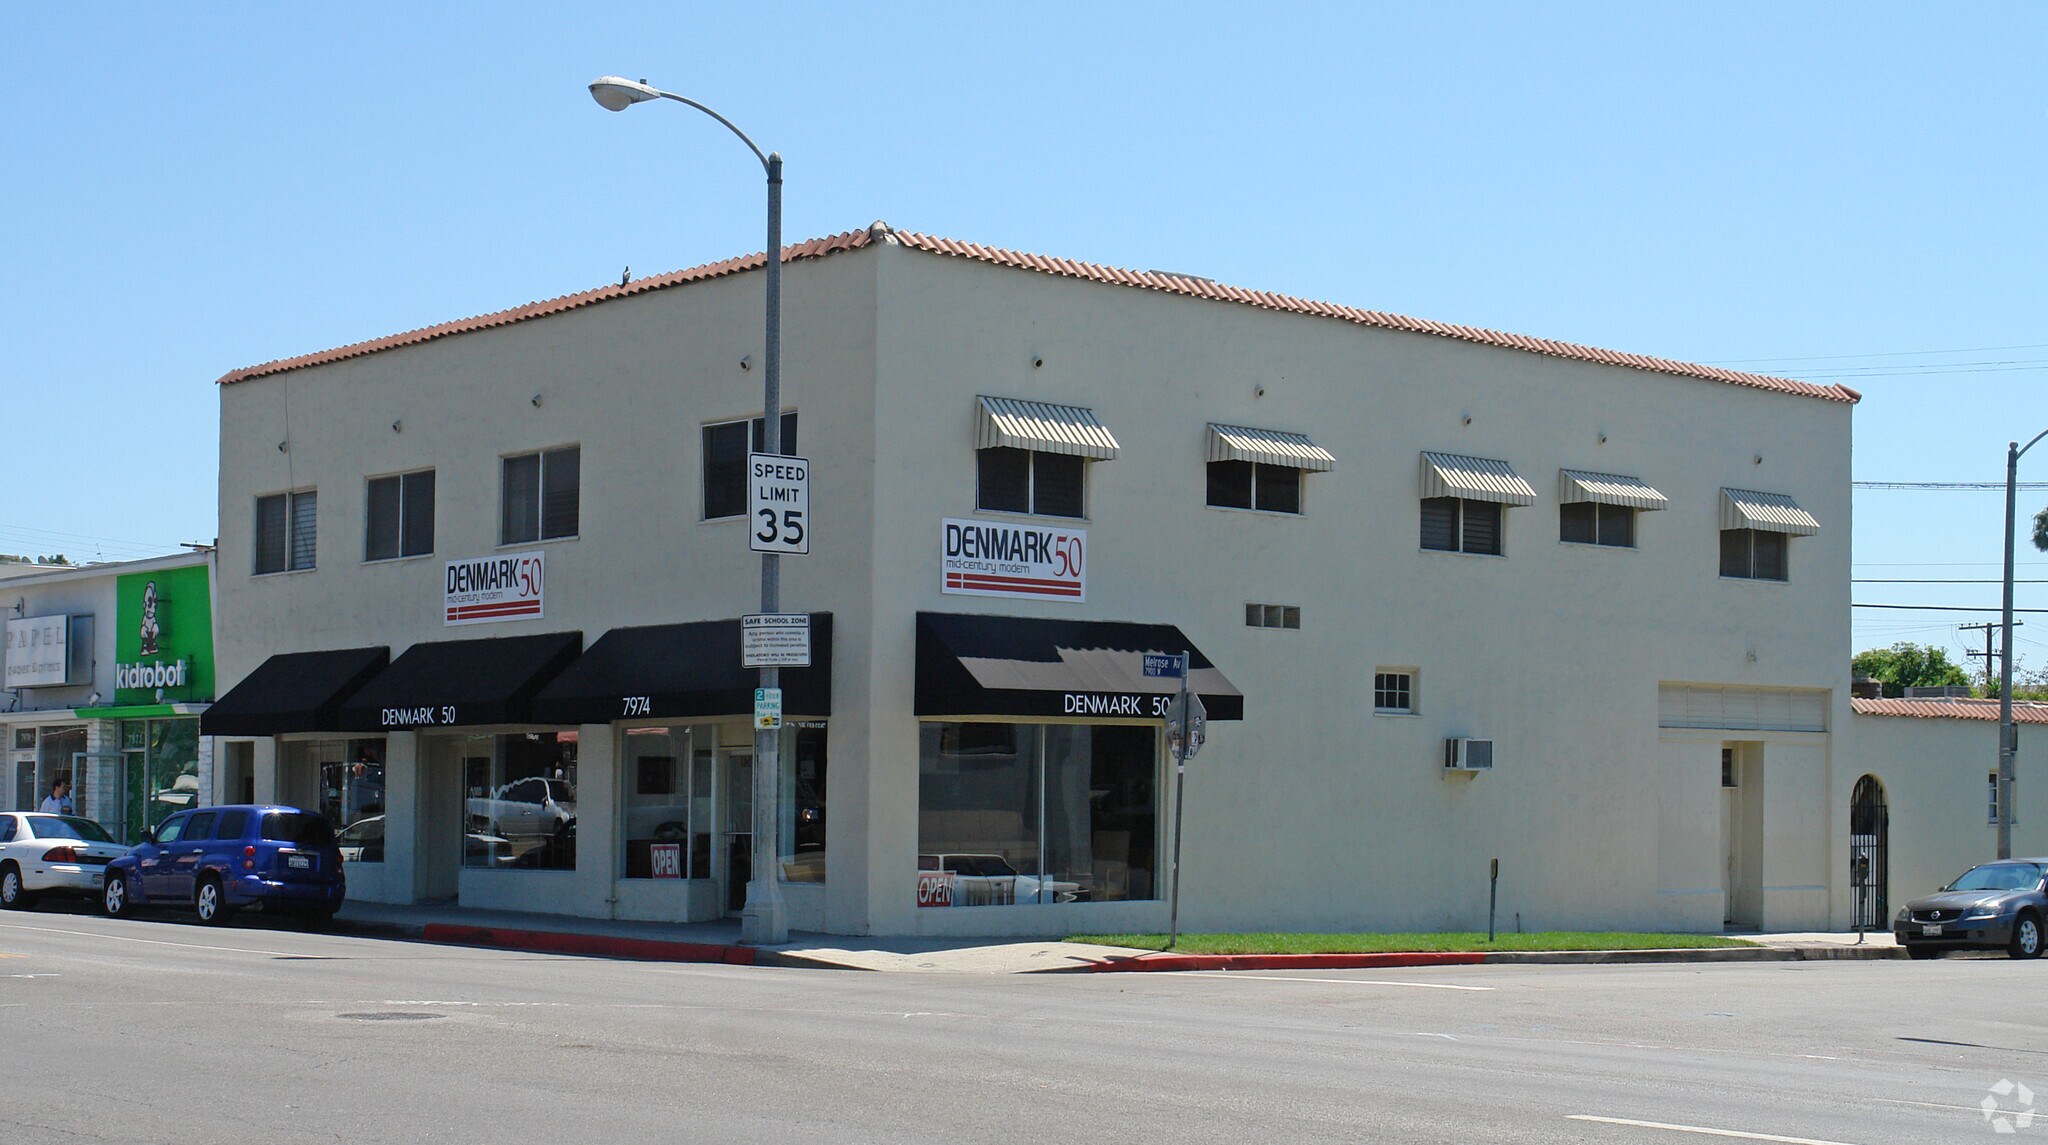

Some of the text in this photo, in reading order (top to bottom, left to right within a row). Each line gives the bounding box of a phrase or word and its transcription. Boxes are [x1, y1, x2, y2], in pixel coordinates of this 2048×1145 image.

[754, 463, 805, 481] SPEED
[760, 486, 799, 502] LIMIT
[756, 508, 804, 545] 35
[946, 558, 996, 574] mid-century
[765, 617, 788, 625] SCHOOL
[1145, 656, 1181, 669] Melrose Av
[116, 659, 186, 689] kidrobot
[757, 690, 764, 700] 2
[1064, 693, 1170, 716] DENMARK 50
[382, 705, 456, 725] DENMARK 50
[622, 696, 650, 716] 7974
[756, 702, 780, 710] PARKING
[653, 849, 679, 875] OPEN
[918, 877, 953, 904] OPEN
